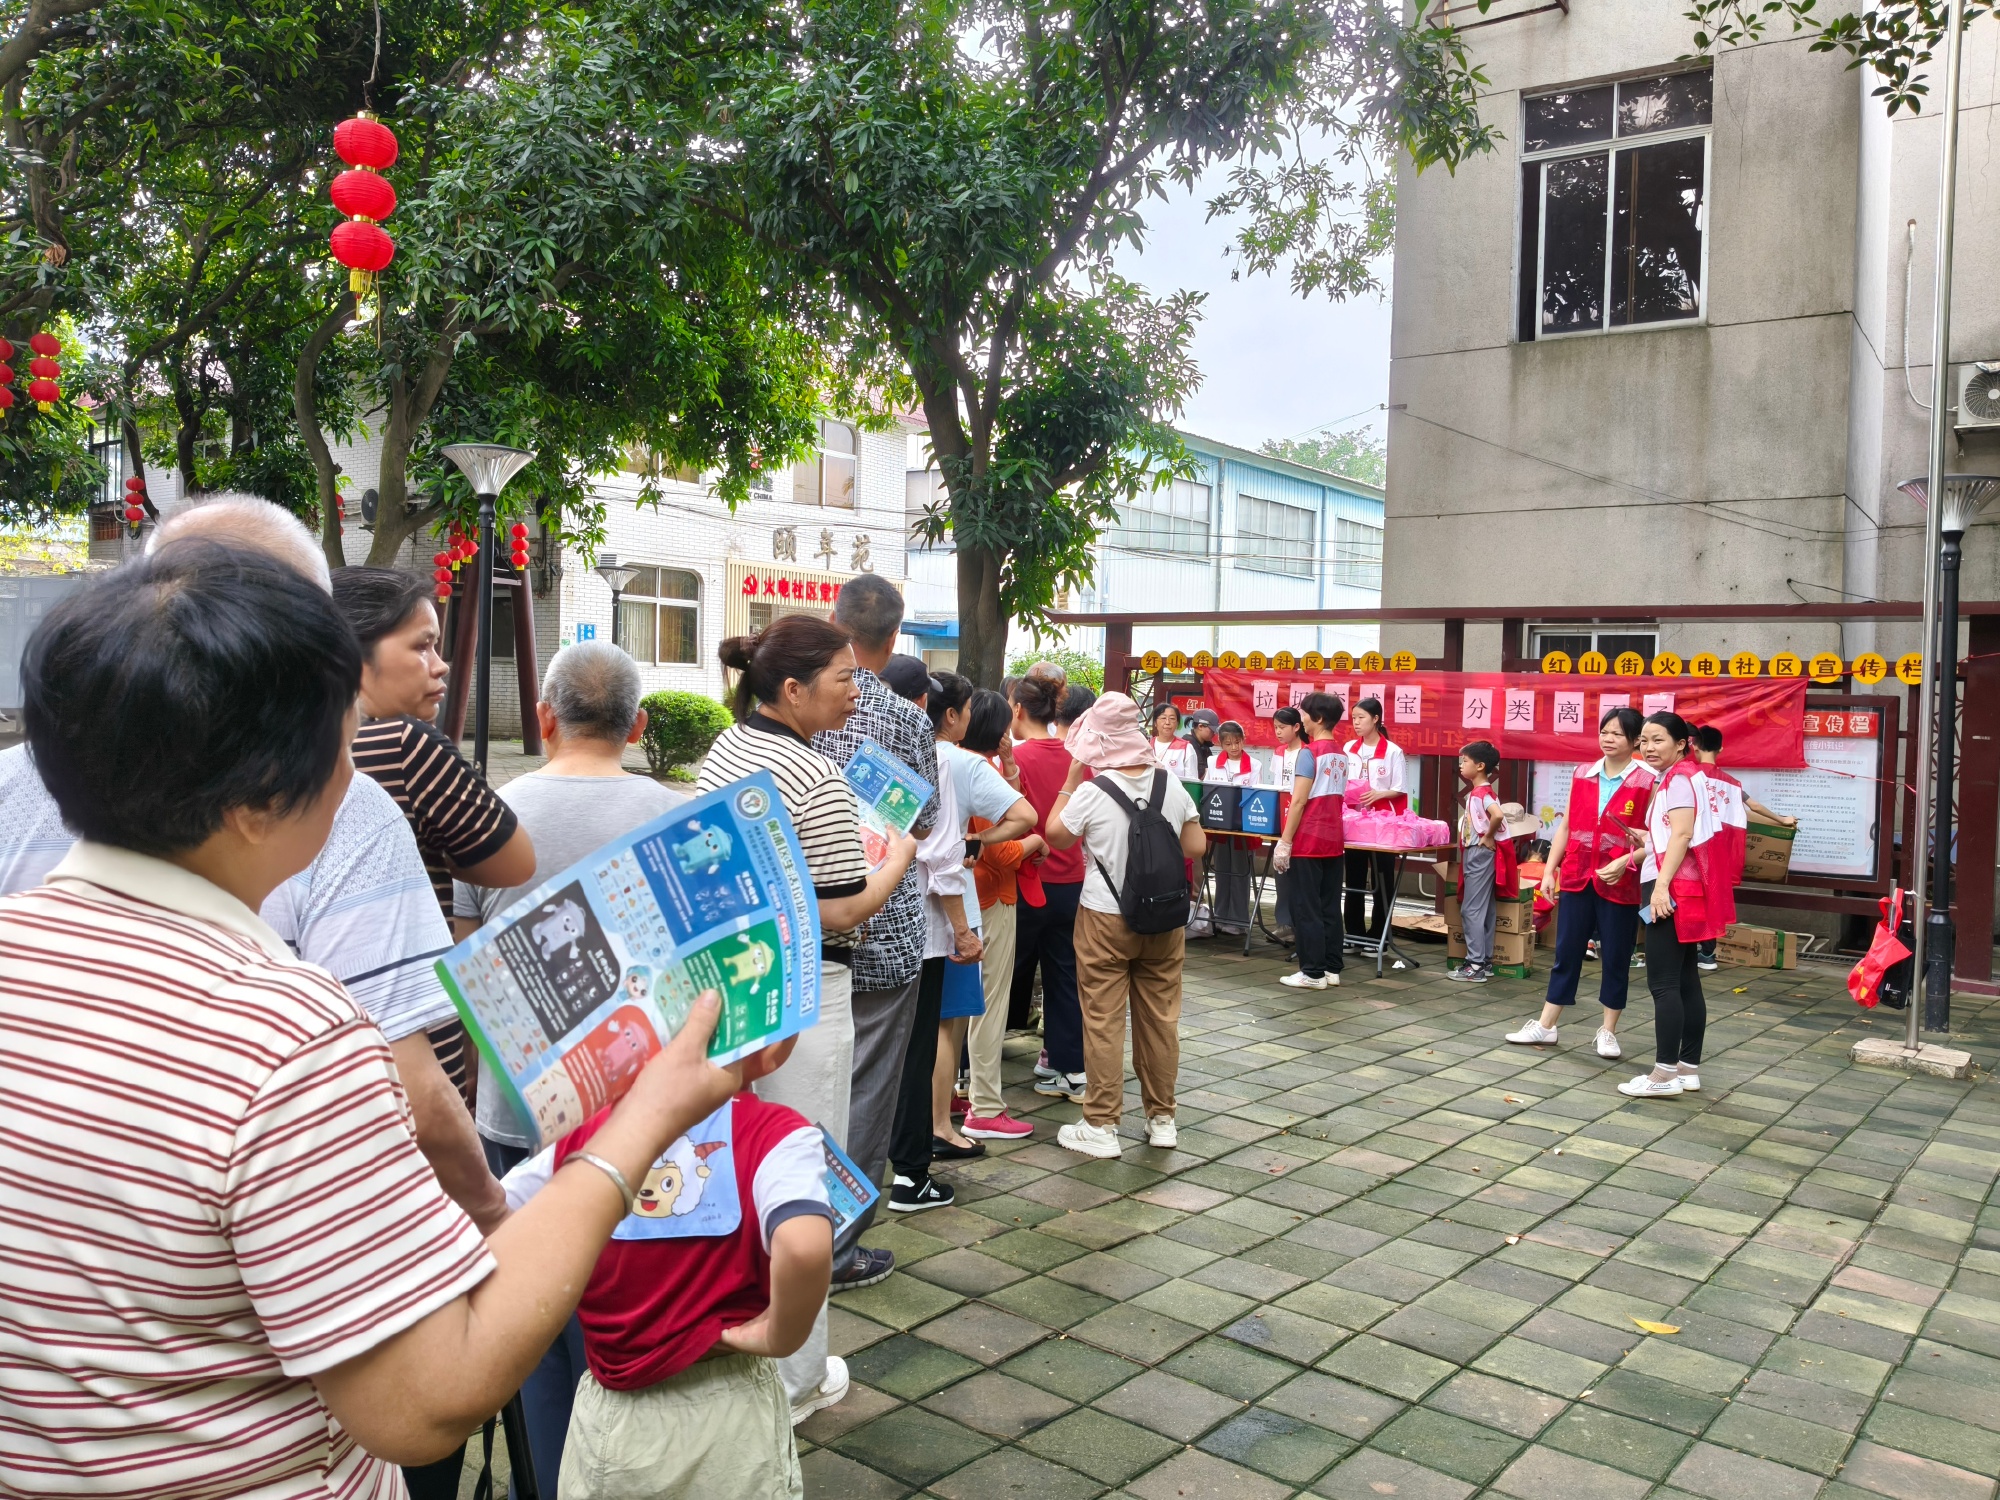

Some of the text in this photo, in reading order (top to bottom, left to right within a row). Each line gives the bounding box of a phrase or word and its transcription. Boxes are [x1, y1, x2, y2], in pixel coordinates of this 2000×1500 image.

[1145, 654, 1412, 671] 红山街火电社区宣传栏
[1548, 657, 1922, 678] 红山街火电社区宣传栏
[1248, 814, 1268, 823] 可回收物
